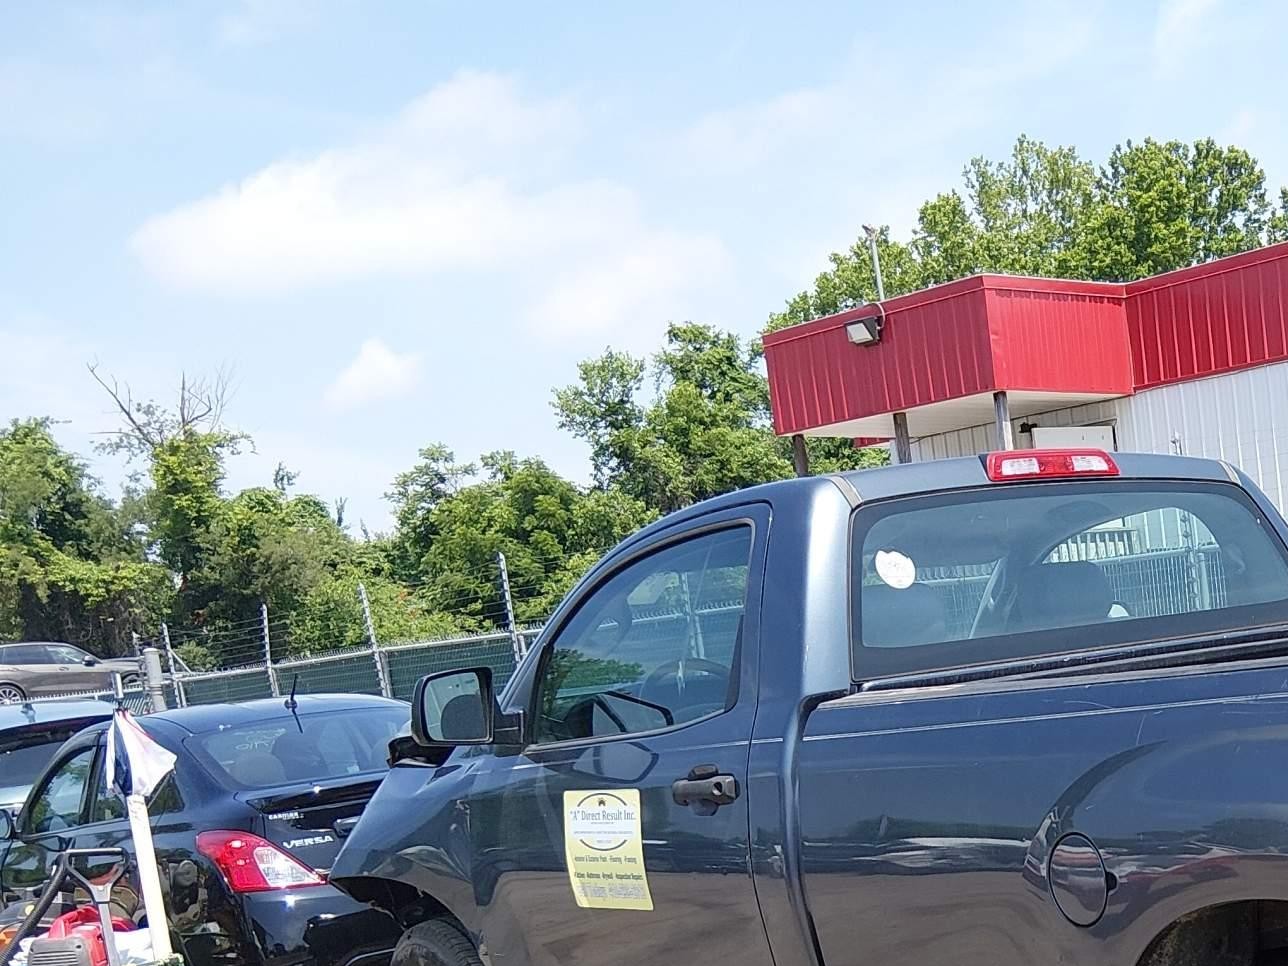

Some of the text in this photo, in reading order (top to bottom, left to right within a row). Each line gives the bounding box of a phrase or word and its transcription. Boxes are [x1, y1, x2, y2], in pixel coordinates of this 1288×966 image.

[581, 809, 601, 821] Direct
[602, 809, 622, 822] Result
[624, 810, 637, 820] Inc.
[283, 835, 333, 848] VERSA
